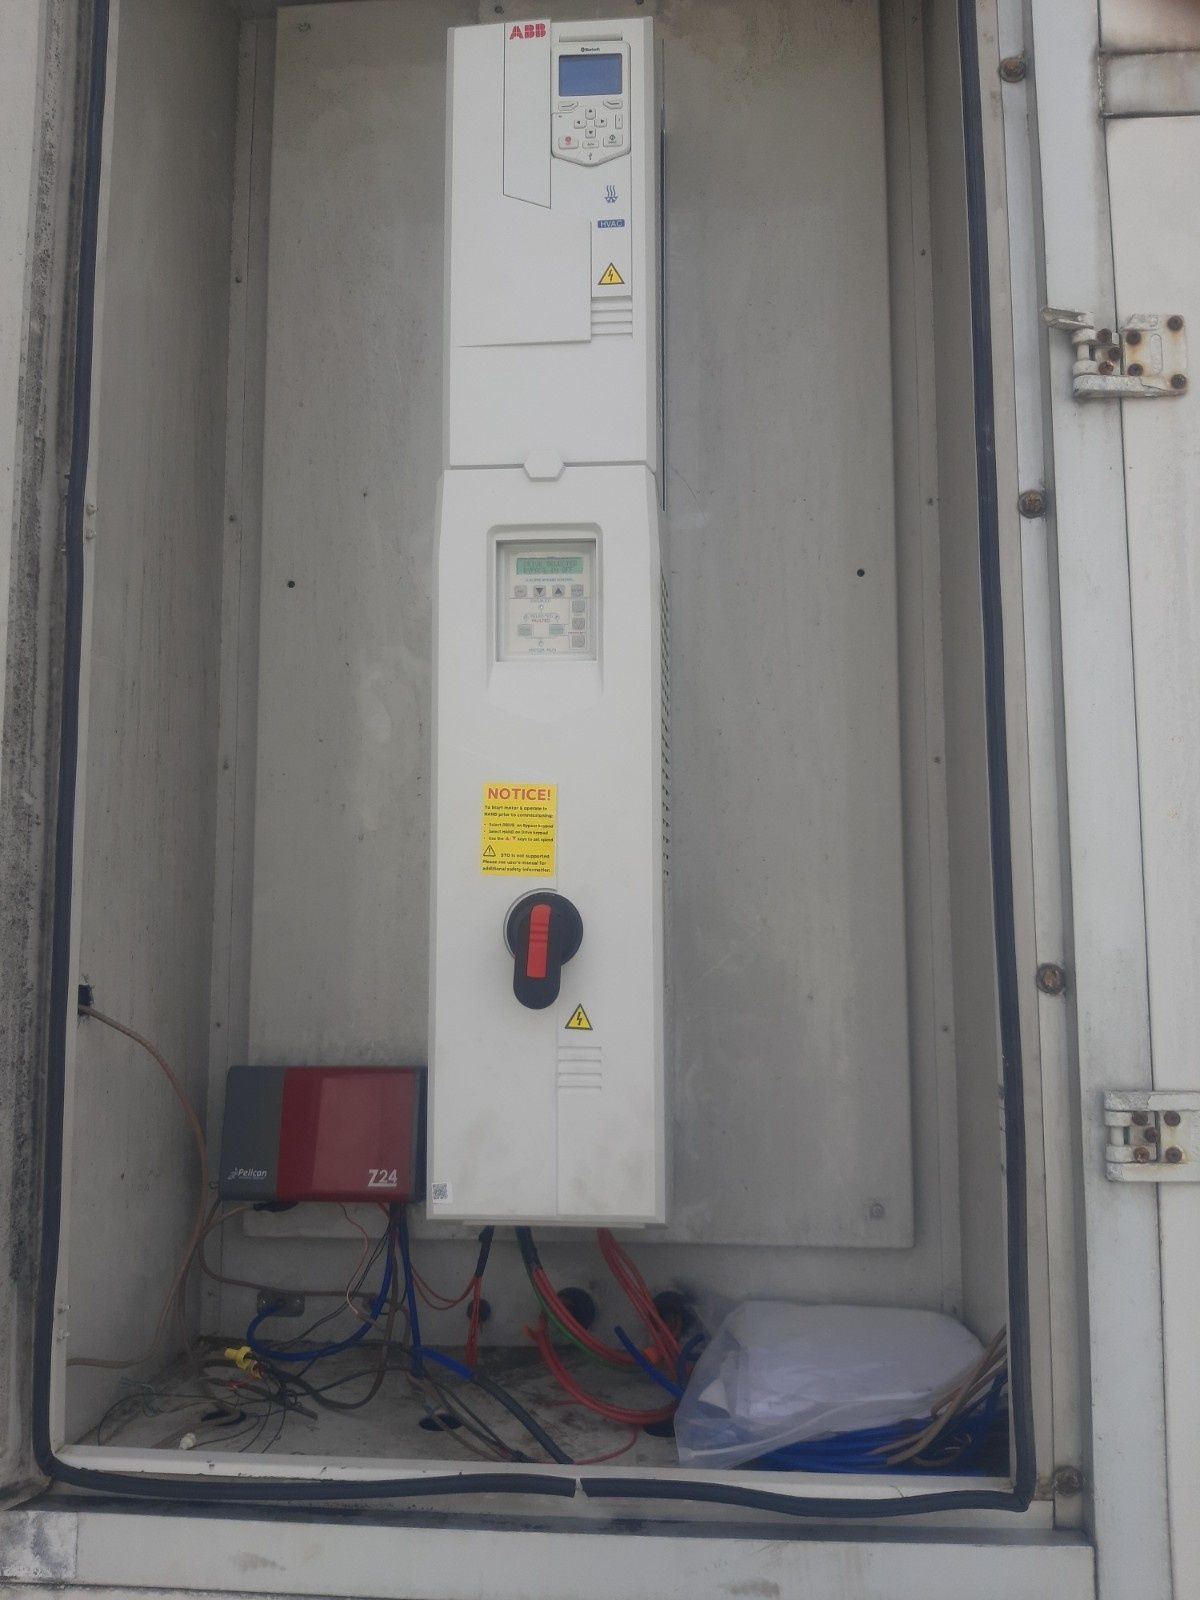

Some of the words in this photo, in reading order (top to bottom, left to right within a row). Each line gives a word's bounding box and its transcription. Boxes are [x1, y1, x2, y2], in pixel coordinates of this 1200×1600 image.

[510, 23, 547, 40] ABB
[600, 219, 624, 228] HVAC
[488, 788, 551, 801] NOTICE!
[237, 1168, 267, 1177] Pelican
[368, 1169, 398, 1187] Z24
